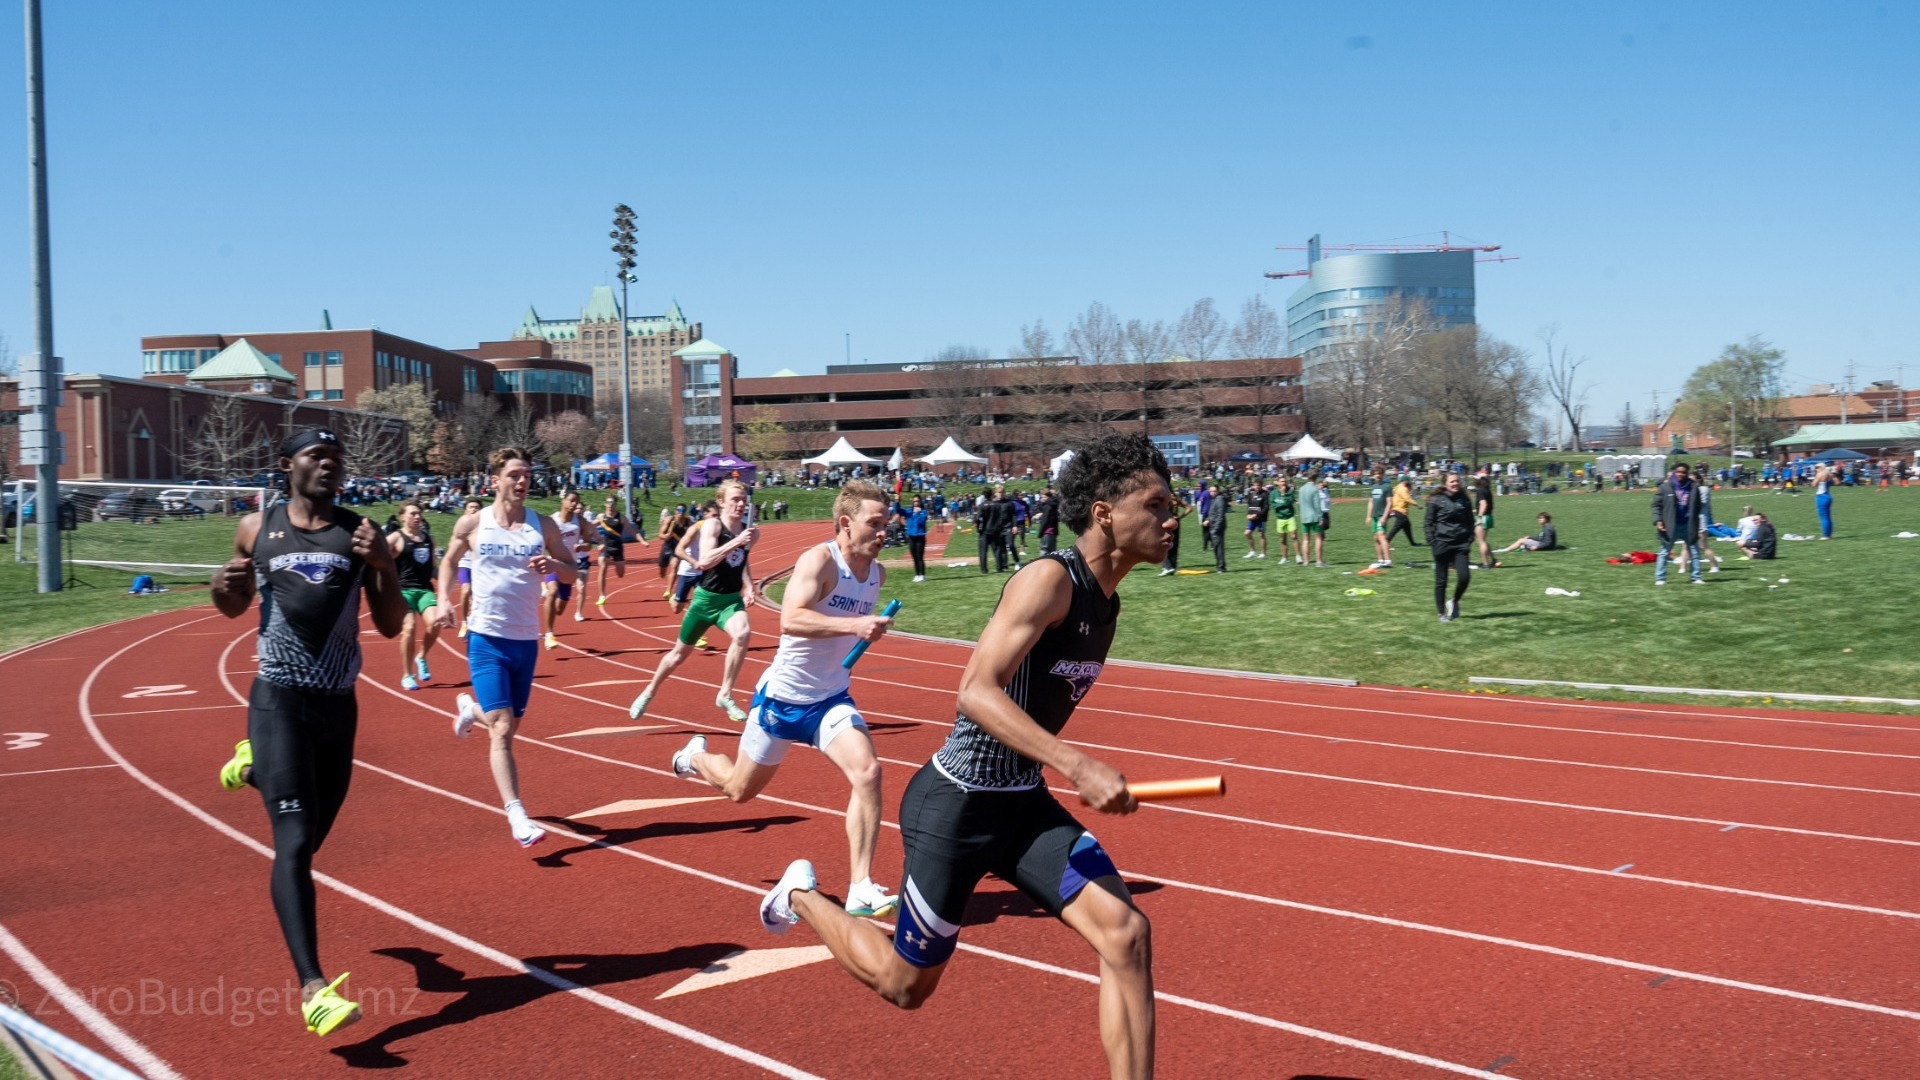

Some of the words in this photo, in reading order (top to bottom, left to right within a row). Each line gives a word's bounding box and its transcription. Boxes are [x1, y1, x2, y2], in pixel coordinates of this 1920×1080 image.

[480, 543, 511, 556] SAINT
[513, 544, 543, 557] LOUIS
[828, 594, 860, 613] SAINT
